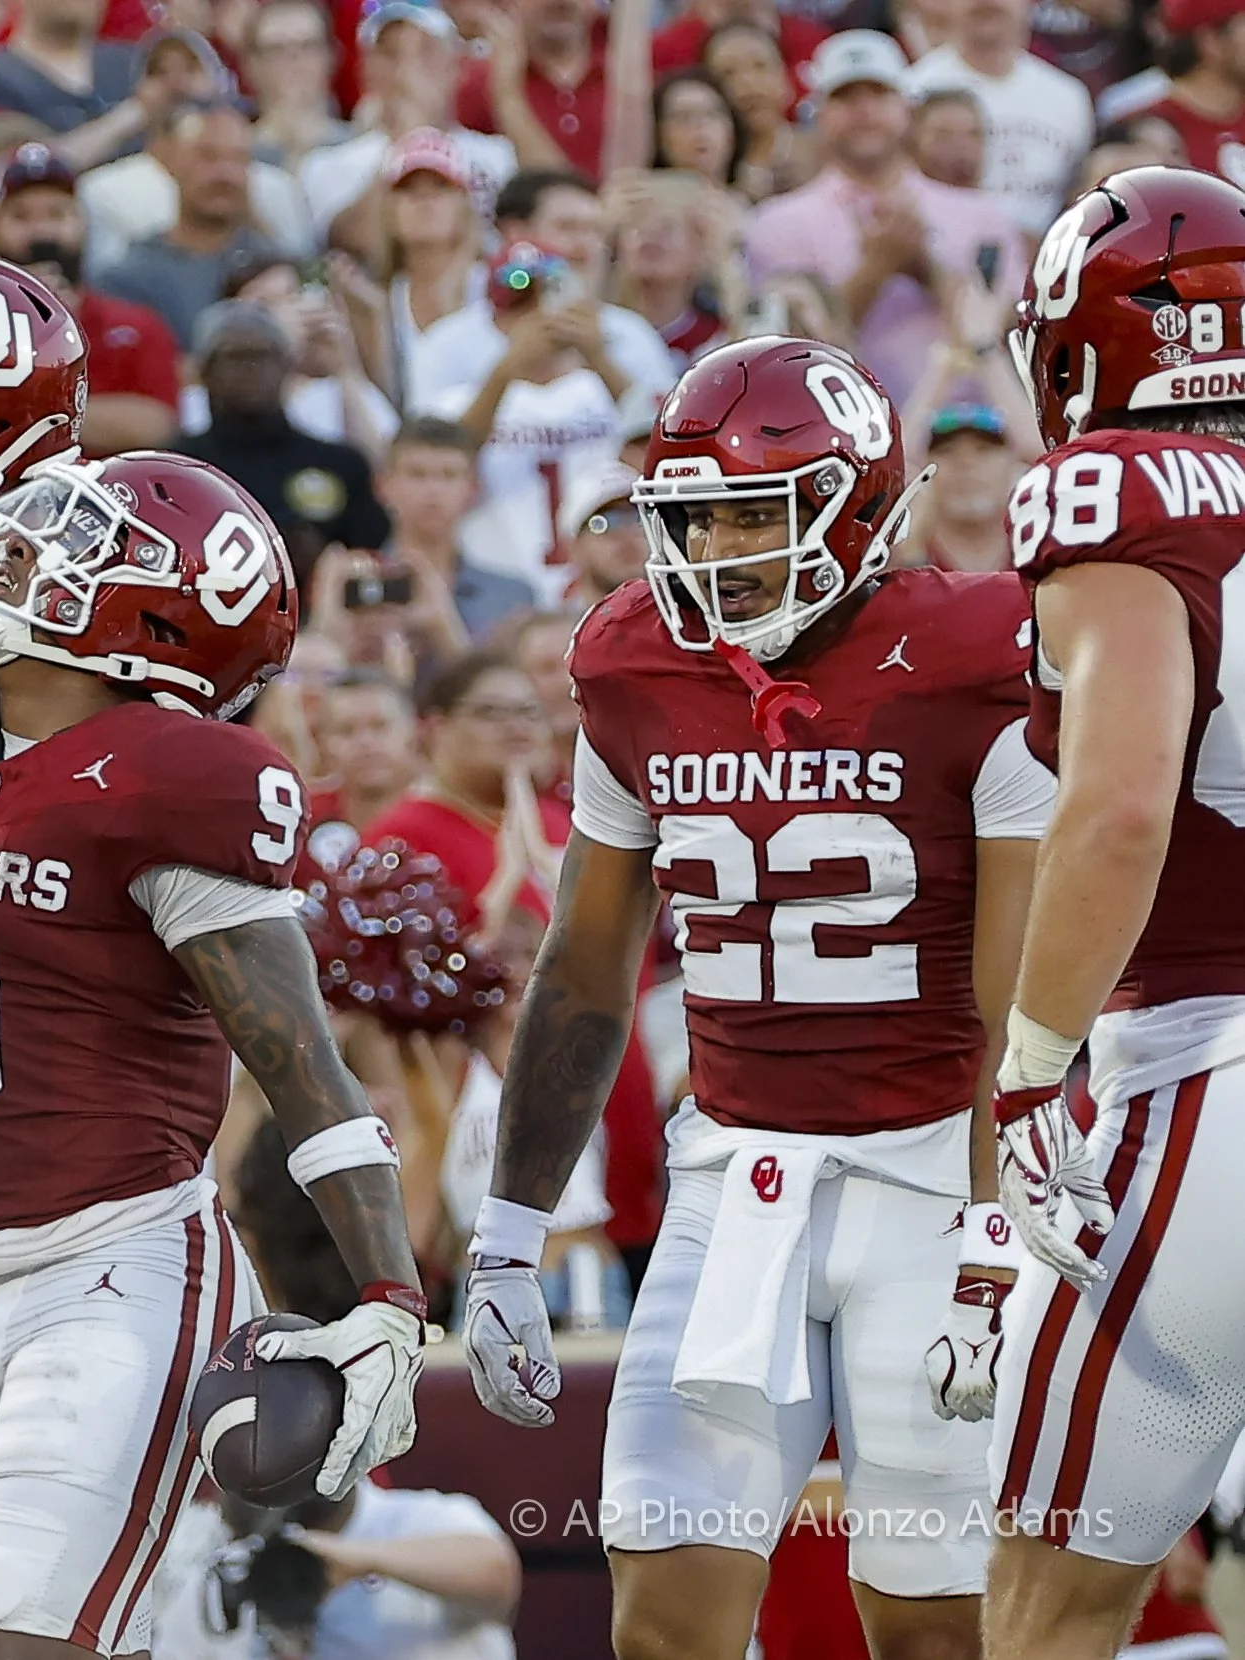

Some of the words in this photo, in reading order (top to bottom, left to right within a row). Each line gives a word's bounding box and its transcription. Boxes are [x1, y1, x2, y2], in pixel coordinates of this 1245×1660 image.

[1155, 307, 1185, 339] SEC
[1190, 303, 1245, 353] 8
[806, 363, 892, 461] OU
[1009, 452, 1124, 568] 88
[201, 511, 270, 627] OU
[251, 766, 302, 865] 9
[647, 749, 904, 805] SOONERS
[652, 812, 921, 1003] 22
[750, 1155, 784, 1203] OU
[985, 1214, 1011, 1246] OU
